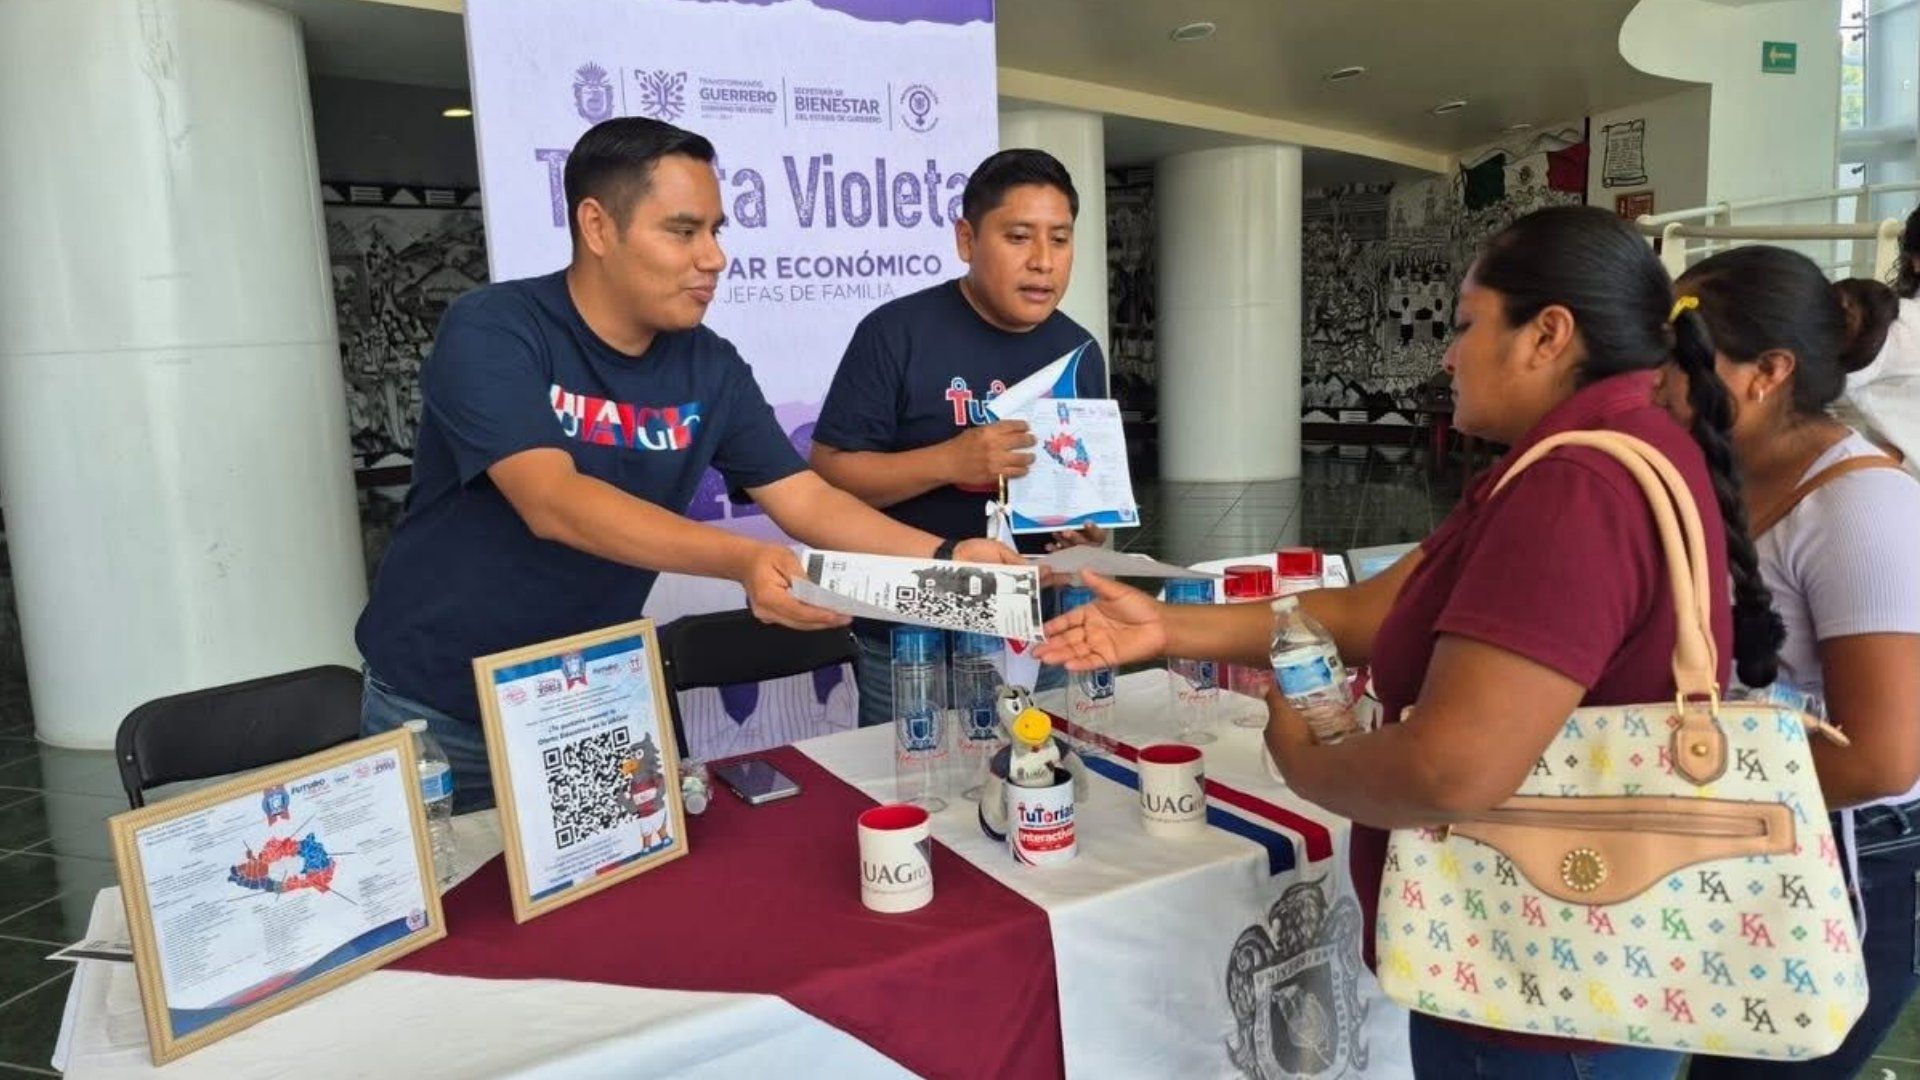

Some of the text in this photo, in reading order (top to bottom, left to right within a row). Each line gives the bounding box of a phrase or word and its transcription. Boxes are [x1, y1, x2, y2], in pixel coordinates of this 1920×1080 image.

[700, 86, 778, 103] GUERRERO
[795, 96, 881, 114] BIENESTAR
[776, 250, 942, 279] ECONÓMICO
[724, 283, 897, 304] JEFAS DE FAMILIA
[1563, 718, 1583, 739] A
[1532, 755, 1552, 776] A
[1736, 748, 1769, 781] KA
[1494, 854, 1519, 887] KA
[1699, 870, 1732, 903] KA
[1401, 880, 1426, 910] KA
[1464, 888, 1488, 920] KA
[1779, 873, 1814, 910] KA
[1522, 895, 1547, 927] KA
[1587, 904, 1616, 936] KA
[1661, 908, 1694, 942] KA
[1428, 920, 1452, 952] KA
[1491, 930, 1516, 962] KA
[1740, 912, 1775, 948] KA
[1551, 936, 1581, 972] KA
[1623, 945, 1656, 978] KA
[1701, 951, 1736, 987] KA
[1454, 961, 1480, 994] KA
[1520, 972, 1547, 1007] KA
[1782, 957, 1819, 995] KA
[1662, 987, 1696, 1024] KA
[1741, 996, 1778, 1034] KA
